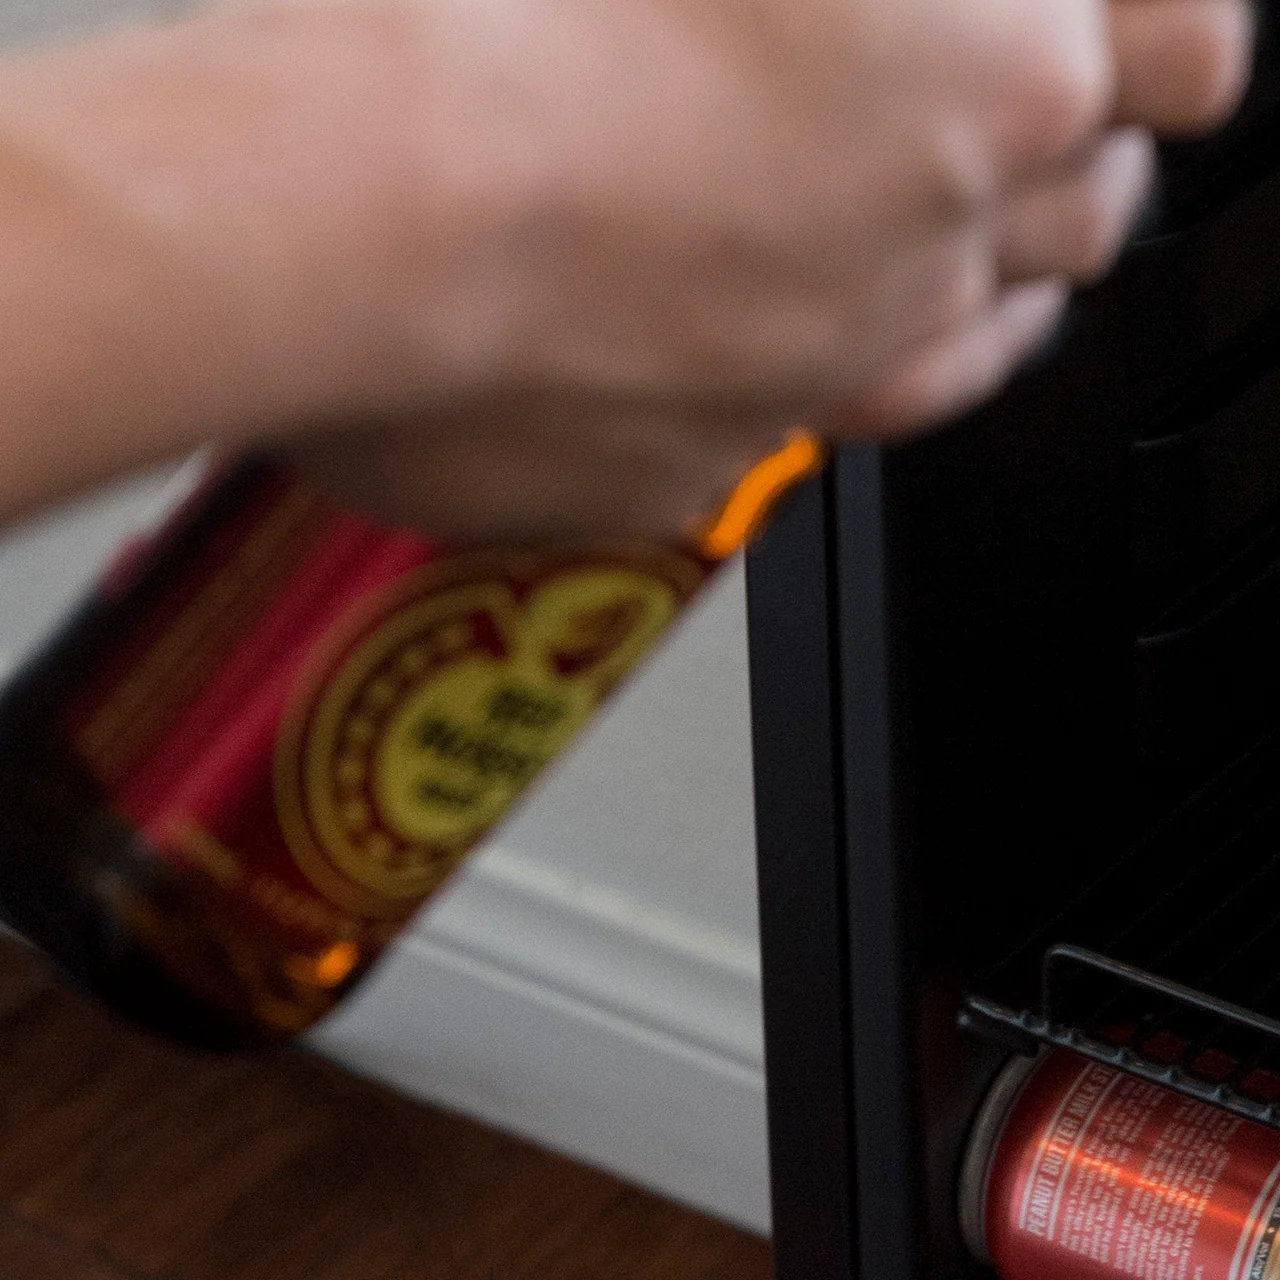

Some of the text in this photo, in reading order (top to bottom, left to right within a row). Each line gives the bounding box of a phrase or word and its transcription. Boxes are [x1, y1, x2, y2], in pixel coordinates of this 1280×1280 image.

[1066, 1079, 1099, 1119] MILK
[1040, 1113, 1079, 1176] BUTTER
[1026, 1175, 1055, 1235] PEANUT
